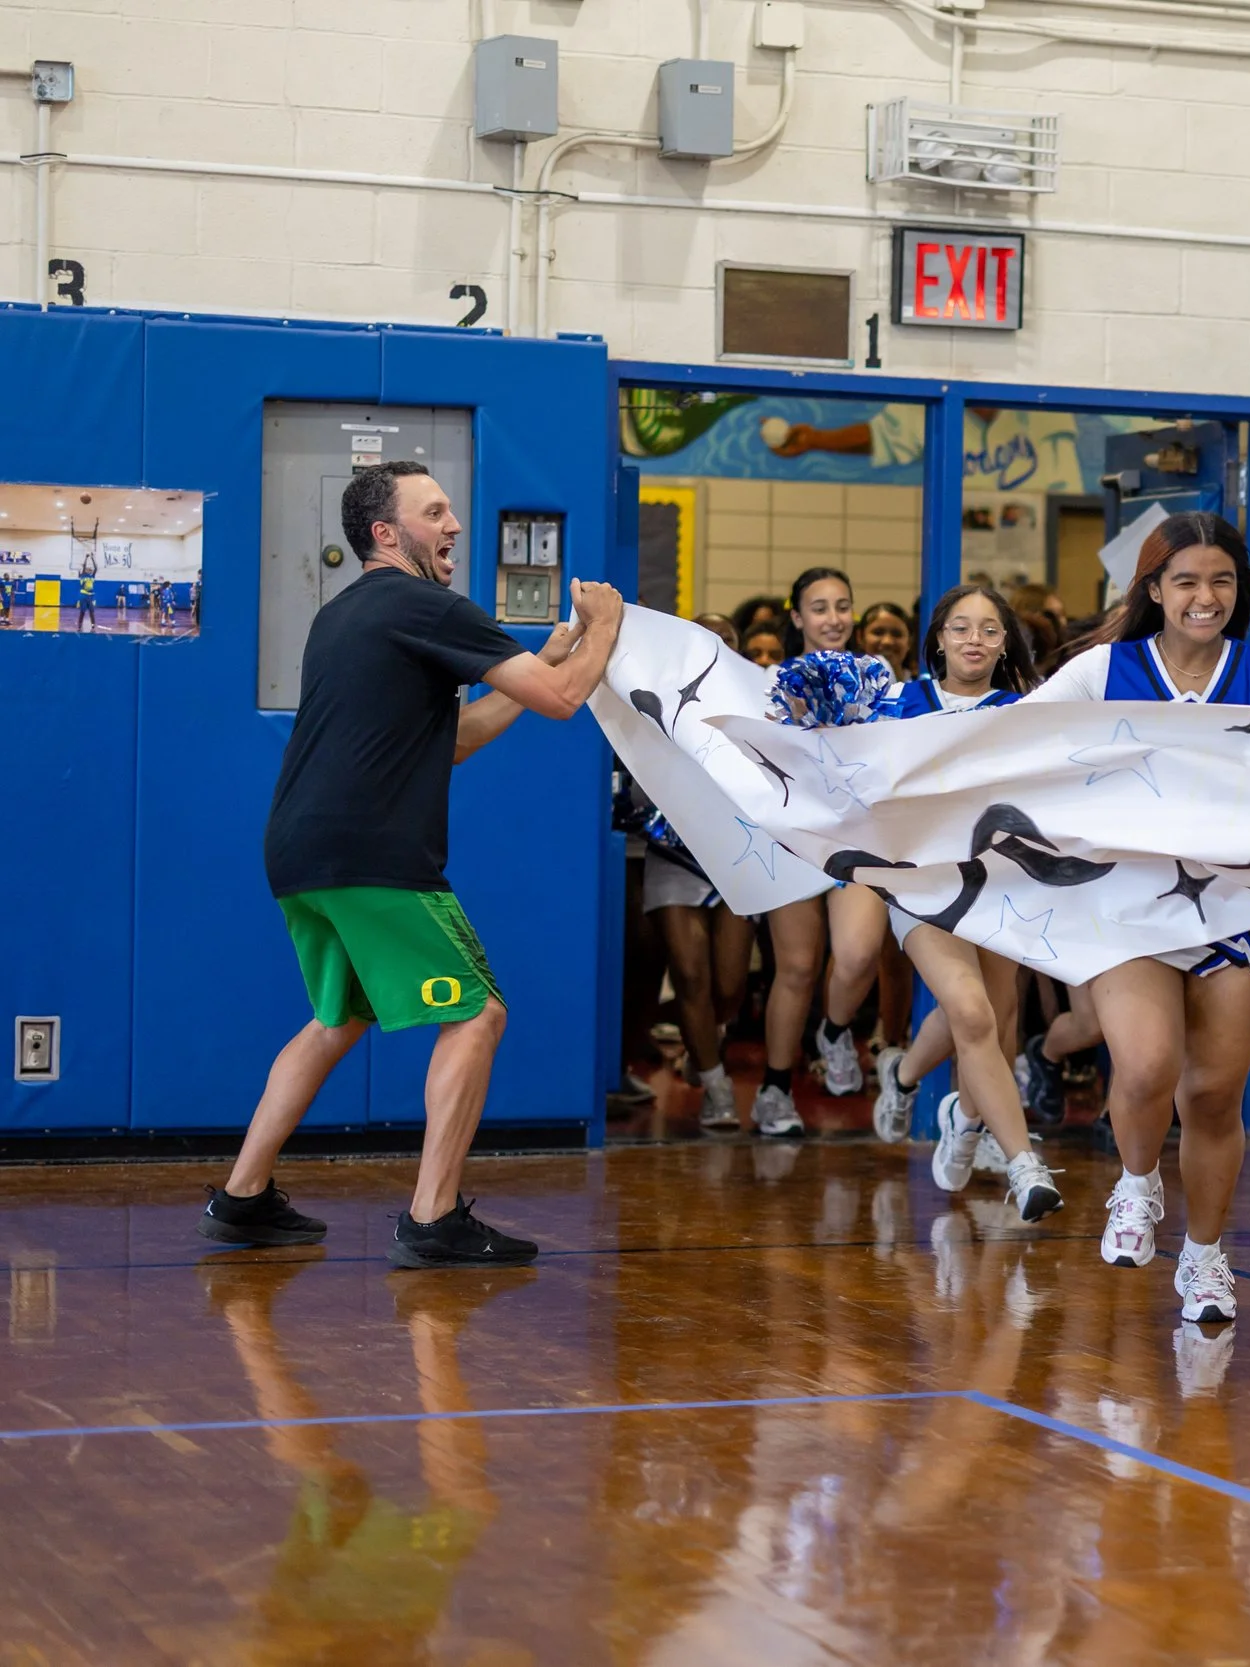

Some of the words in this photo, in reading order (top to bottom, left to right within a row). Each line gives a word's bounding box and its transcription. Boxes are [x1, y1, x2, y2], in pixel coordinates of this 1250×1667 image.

[48, 259, 84, 306] 3
[914, 242, 1016, 321] EXIT
[449, 285, 487, 327] 2
[865, 313, 882, 368] 1
[421, 976, 461, 1007] O
